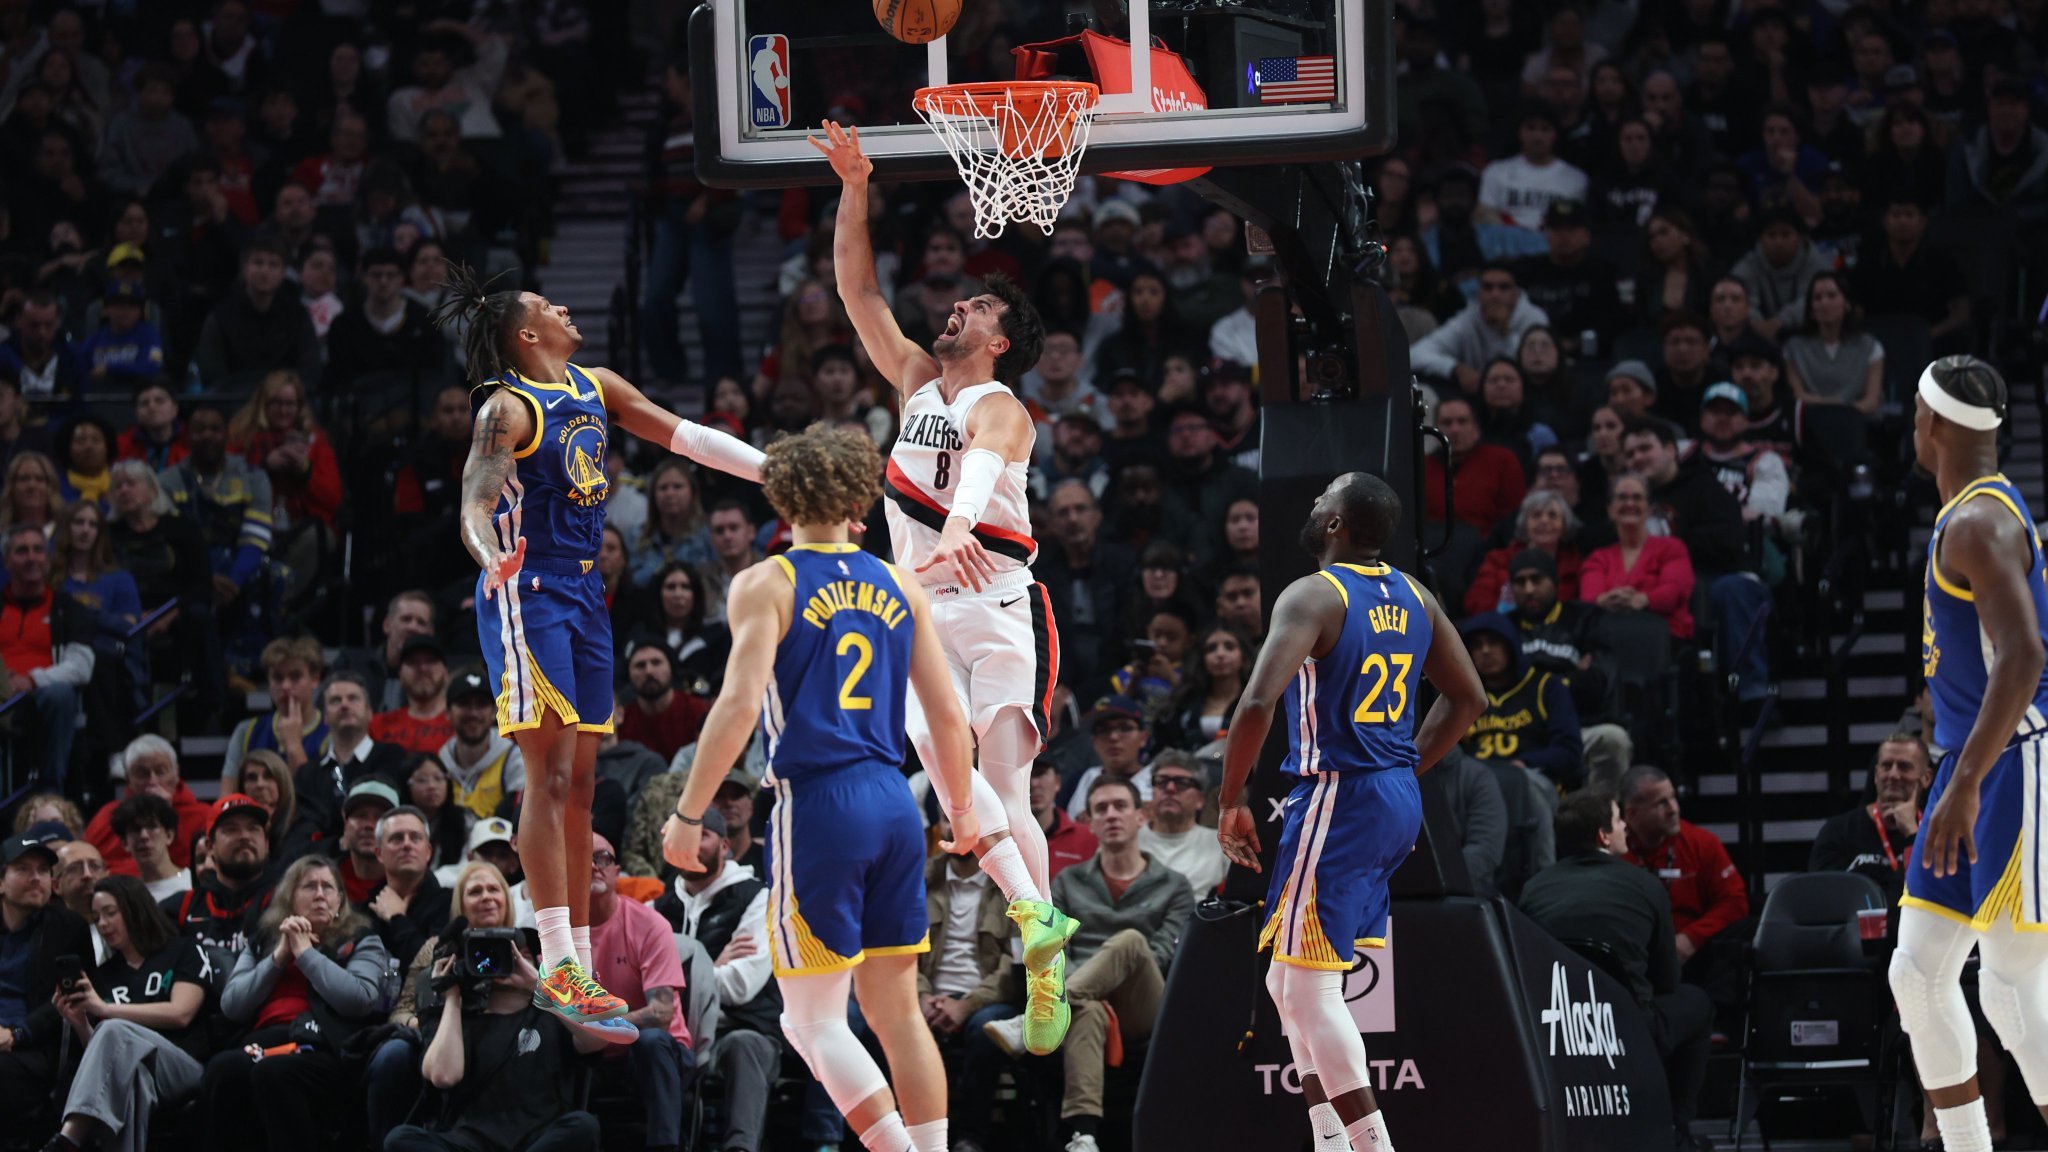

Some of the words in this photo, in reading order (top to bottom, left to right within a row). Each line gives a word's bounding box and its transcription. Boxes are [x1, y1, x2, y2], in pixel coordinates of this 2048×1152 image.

[756, 107, 776, 123] NBA
[559, 414, 588, 444] GOLDEN
[898, 414, 963, 451] BLAZERS
[934, 451, 951, 490] 8
[935, 585, 959, 596] ripcity
[1368, 604, 1409, 636] GREEN
[836, 631, 873, 710] 2
[1353, 653, 1414, 723] 23
[1254, 1058, 1426, 1096] TOTA
[1565, 1084, 1631, 1117] AIRLINES
